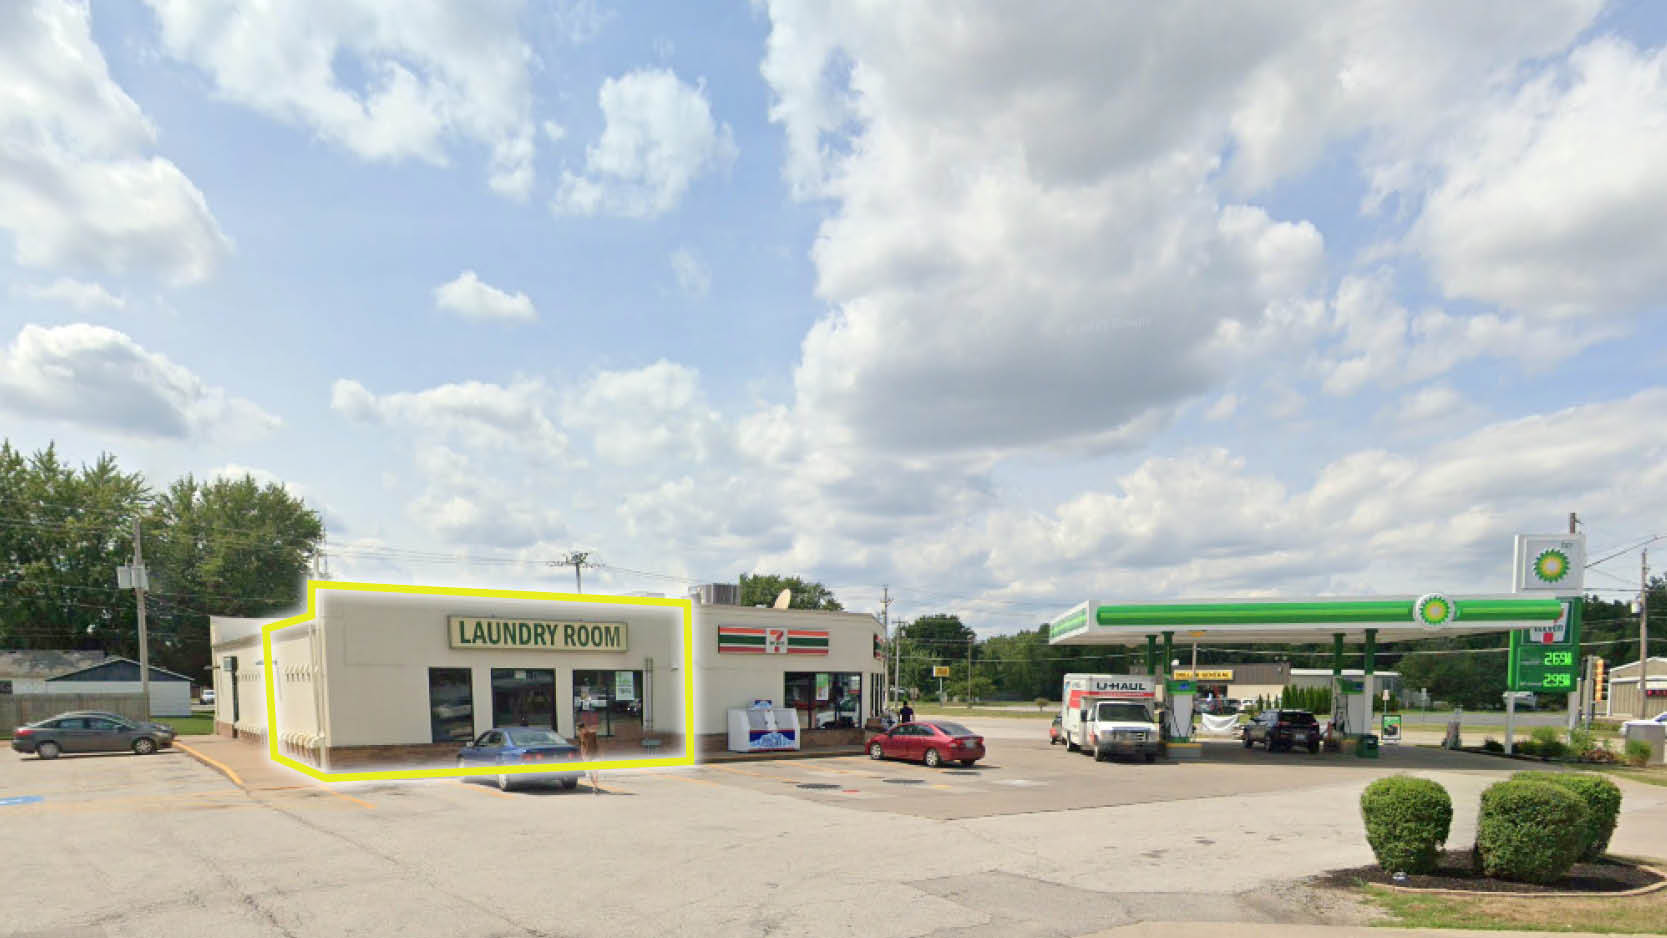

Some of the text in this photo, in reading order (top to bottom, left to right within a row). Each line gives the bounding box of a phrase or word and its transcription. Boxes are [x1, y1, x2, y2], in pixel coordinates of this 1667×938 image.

[459, 620, 620, 647] LAUNDRY ROOM
[1096, 681, 1146, 691] U-HAUL
